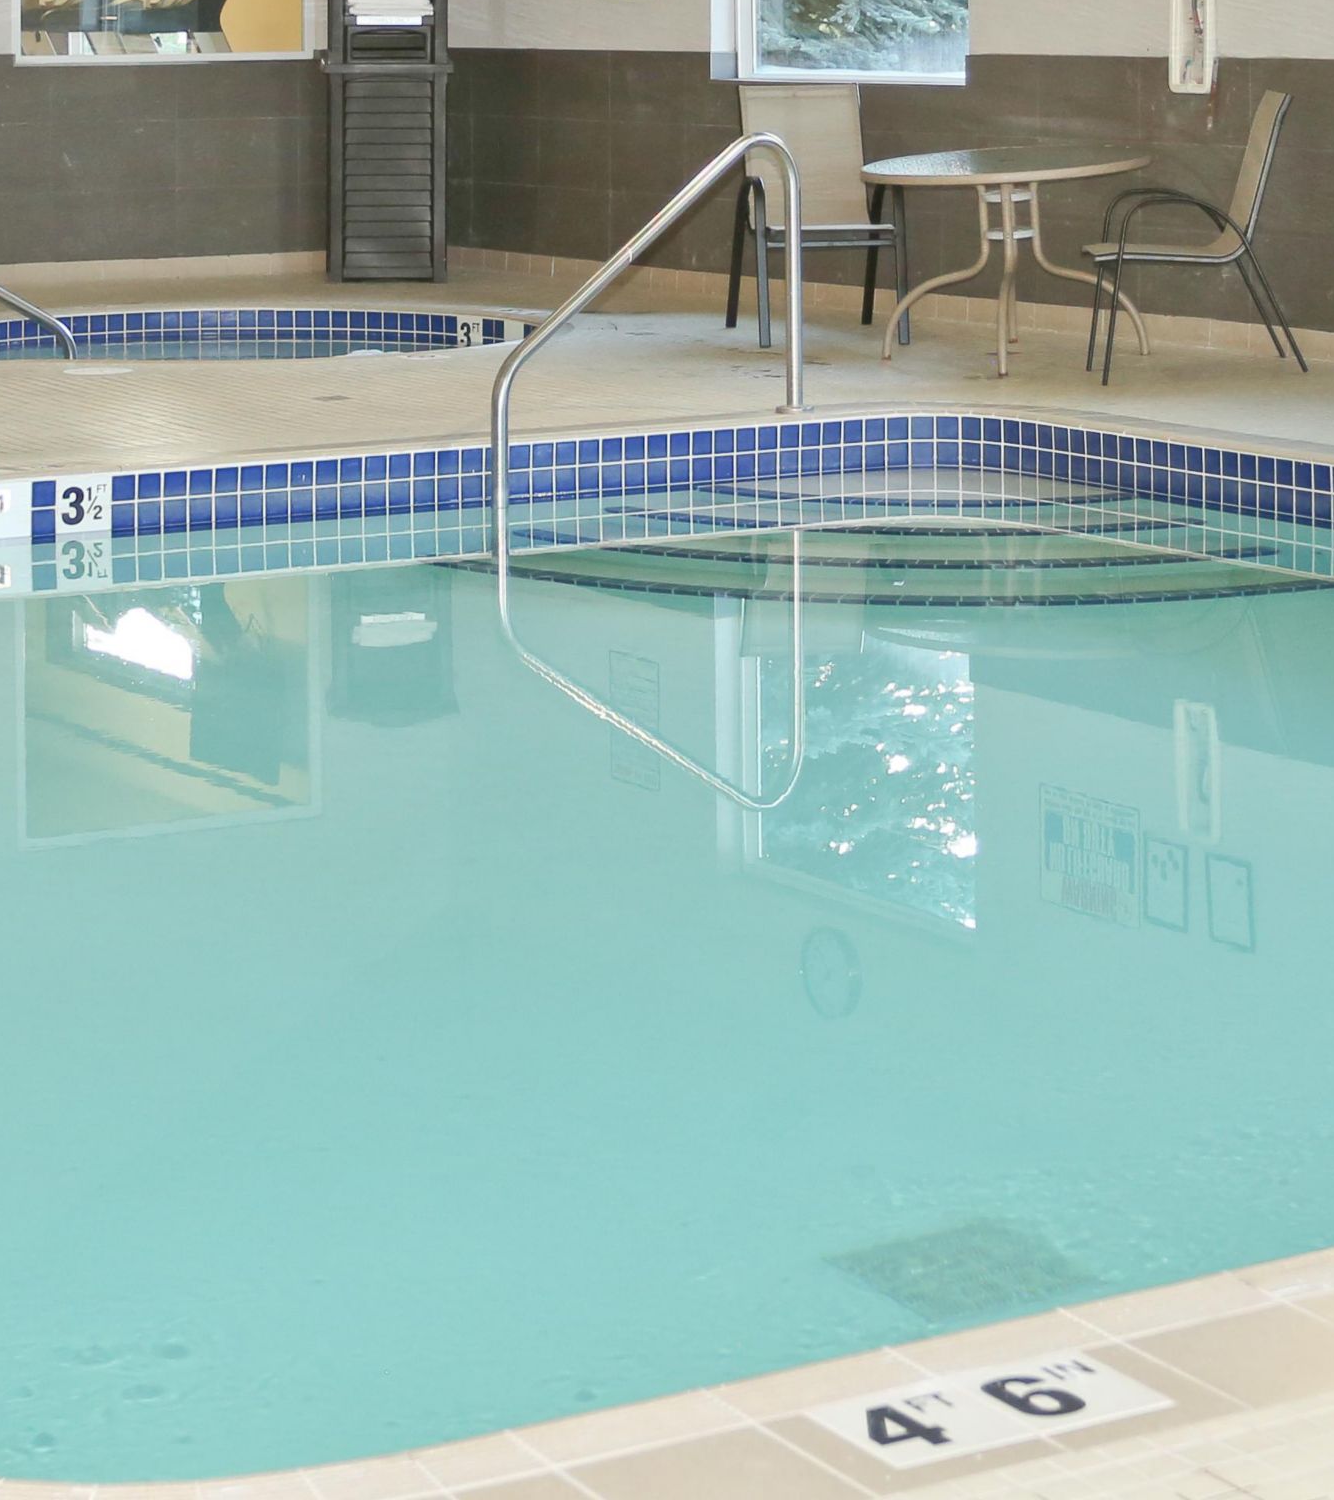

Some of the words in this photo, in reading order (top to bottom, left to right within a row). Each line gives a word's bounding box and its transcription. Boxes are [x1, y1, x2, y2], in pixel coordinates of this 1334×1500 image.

[460, 322, 471, 347] 3
[865, 1405, 952, 1446] 4
[980, 1374, 1087, 1416] 6
